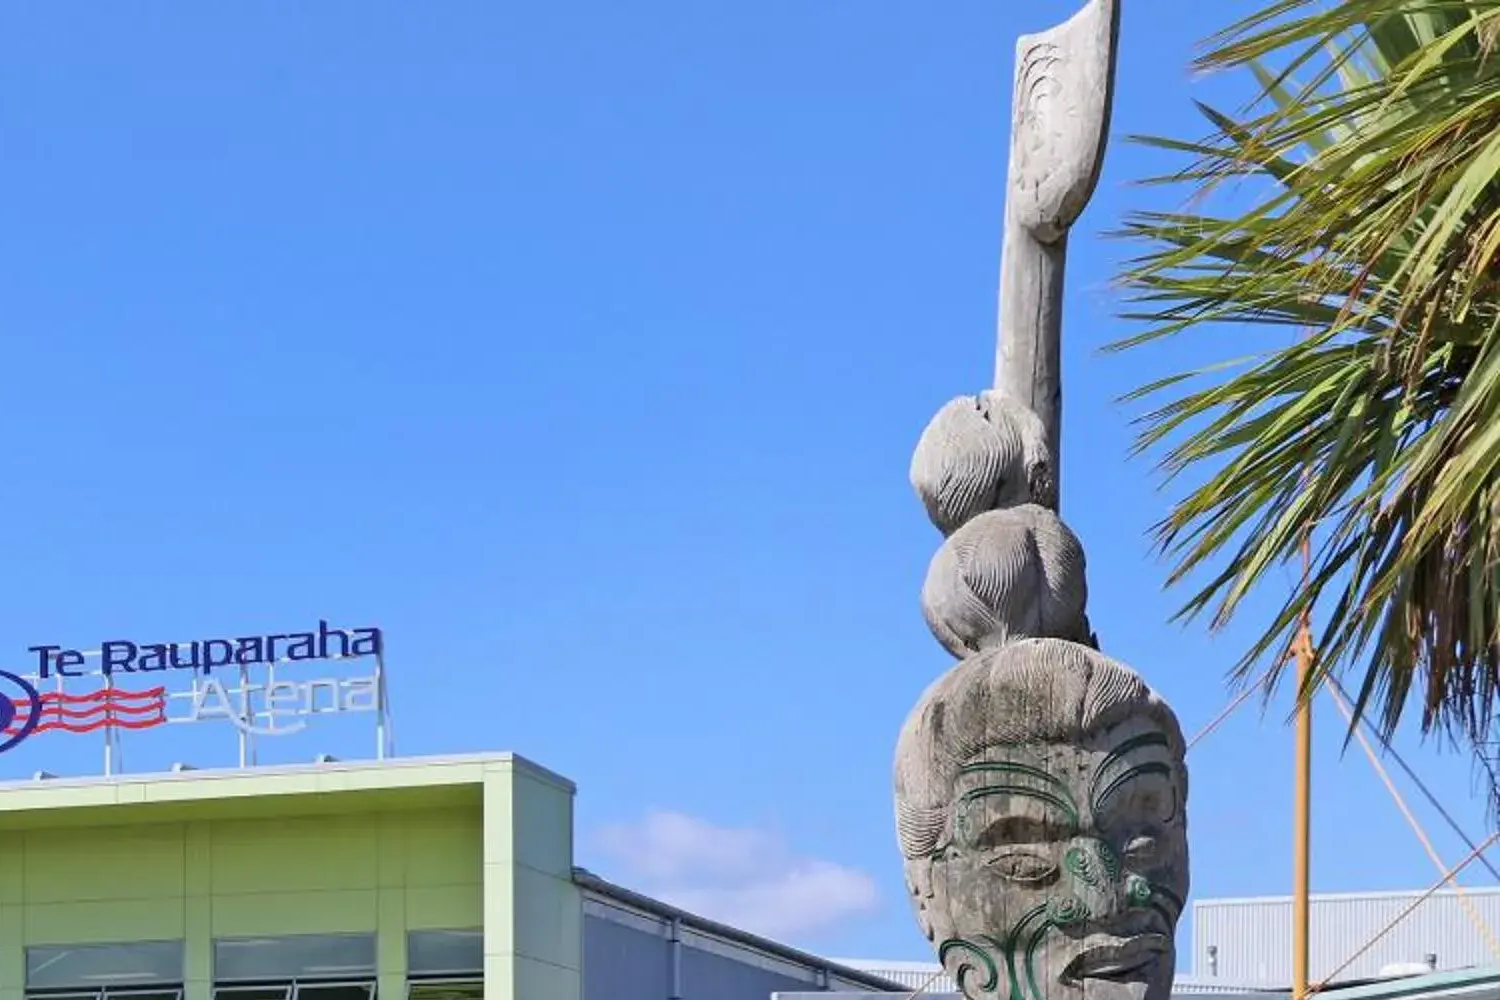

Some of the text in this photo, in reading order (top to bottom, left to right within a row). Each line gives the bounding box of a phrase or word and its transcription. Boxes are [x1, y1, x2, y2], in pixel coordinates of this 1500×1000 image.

[28, 620, 381, 678] Te Rauparaha
[197, 675, 380, 735] Arena
